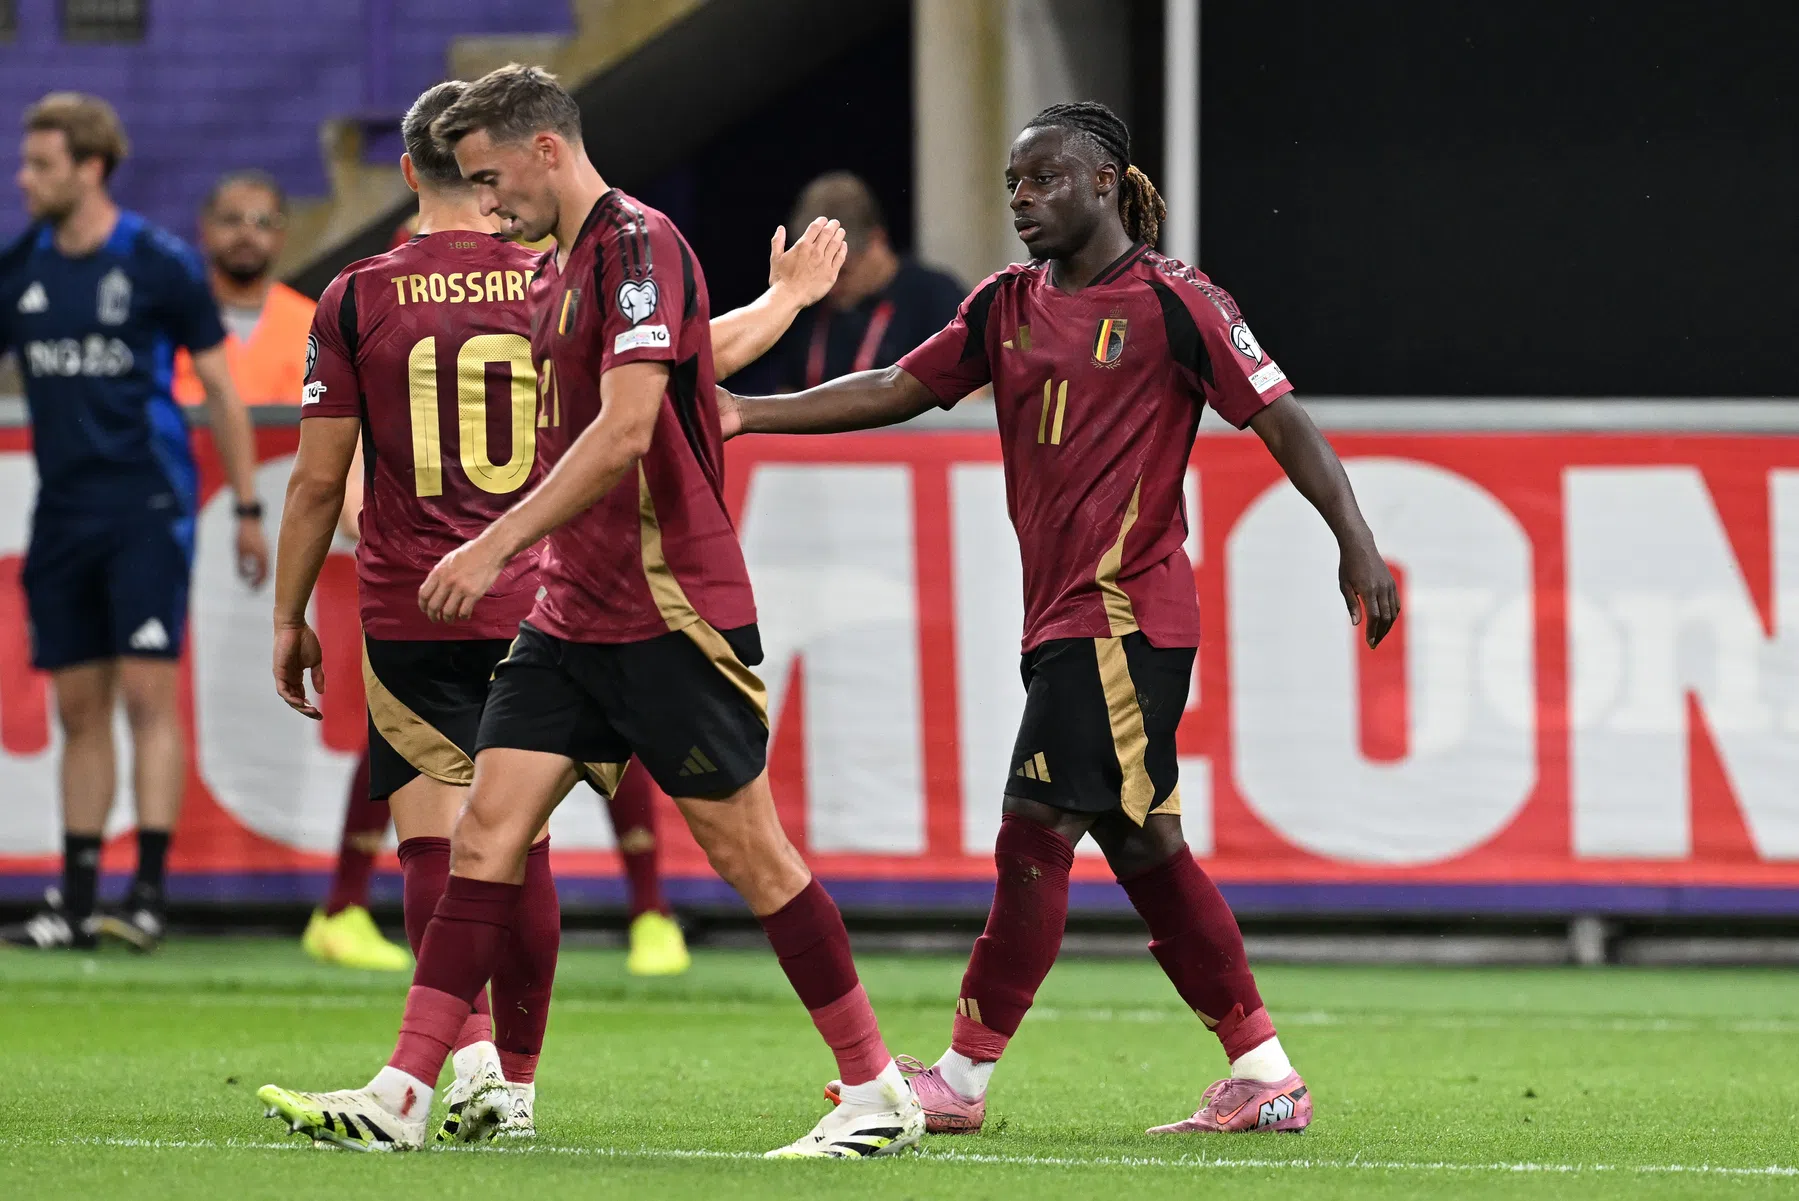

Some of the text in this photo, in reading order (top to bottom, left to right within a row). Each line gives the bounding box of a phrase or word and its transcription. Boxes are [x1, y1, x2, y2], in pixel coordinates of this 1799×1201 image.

[391, 270, 535, 305] TROSSAR
[408, 334, 538, 498] 10
[537, 359, 560, 428] 21
[1037, 378, 1068, 445] 11
